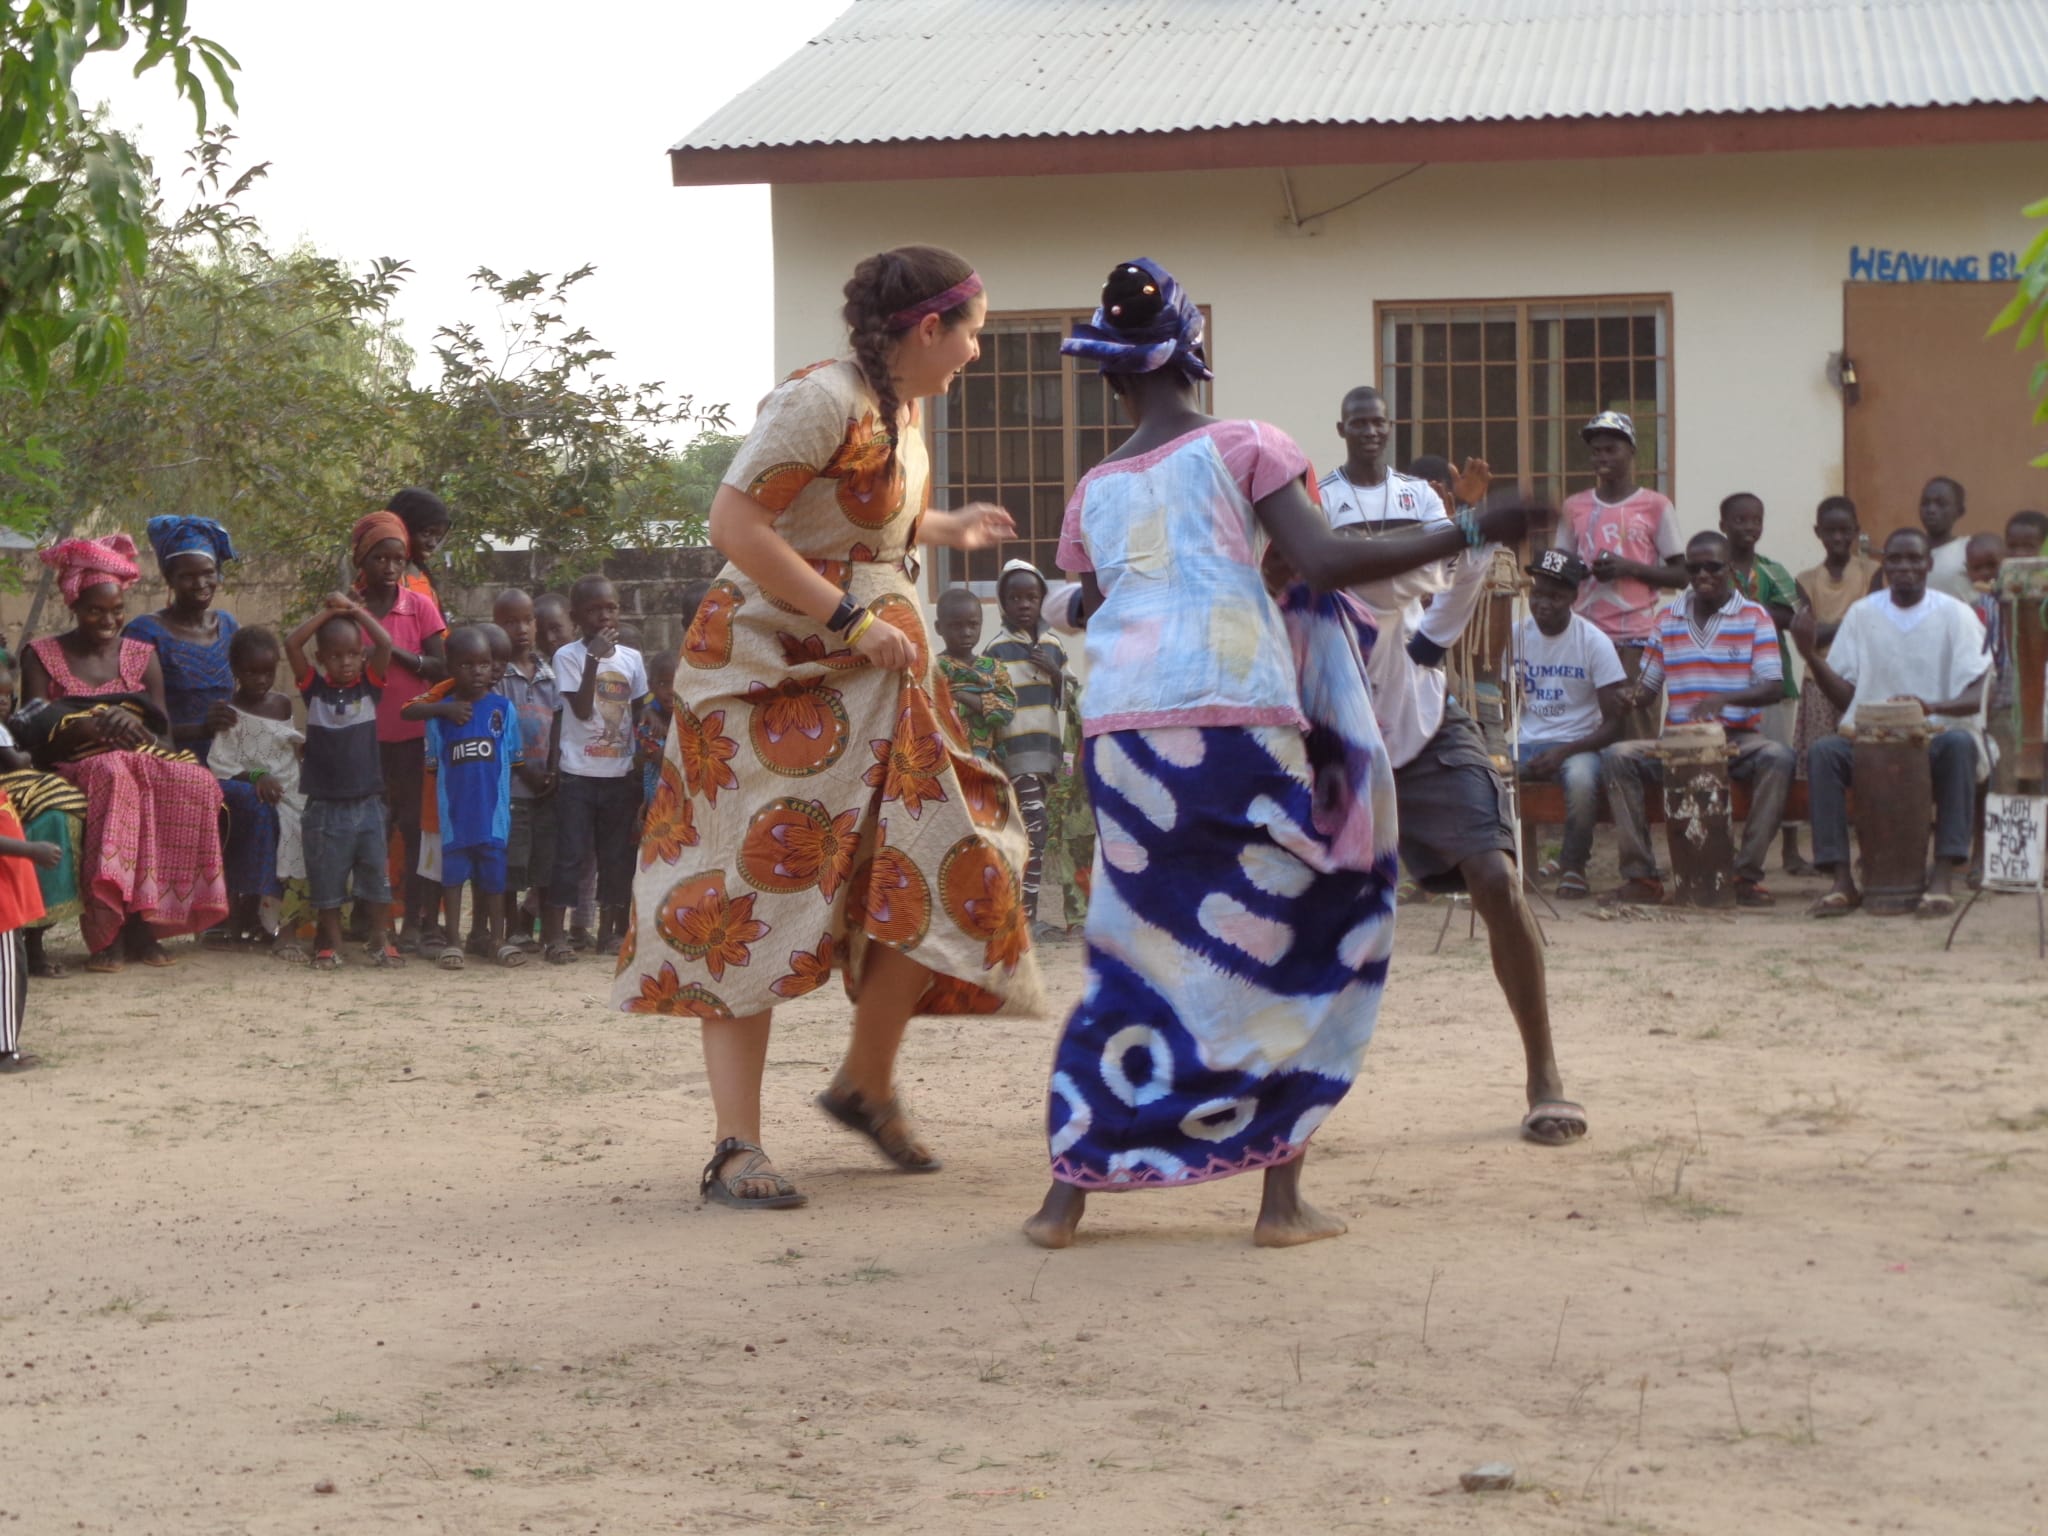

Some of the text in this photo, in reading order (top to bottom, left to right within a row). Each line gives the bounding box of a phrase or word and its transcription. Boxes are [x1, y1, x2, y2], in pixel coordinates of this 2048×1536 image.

[1849, 245, 1979, 282] WEAVING
[1514, 659, 1586, 679] SUMMER
[452, 740, 492, 761] MEO
